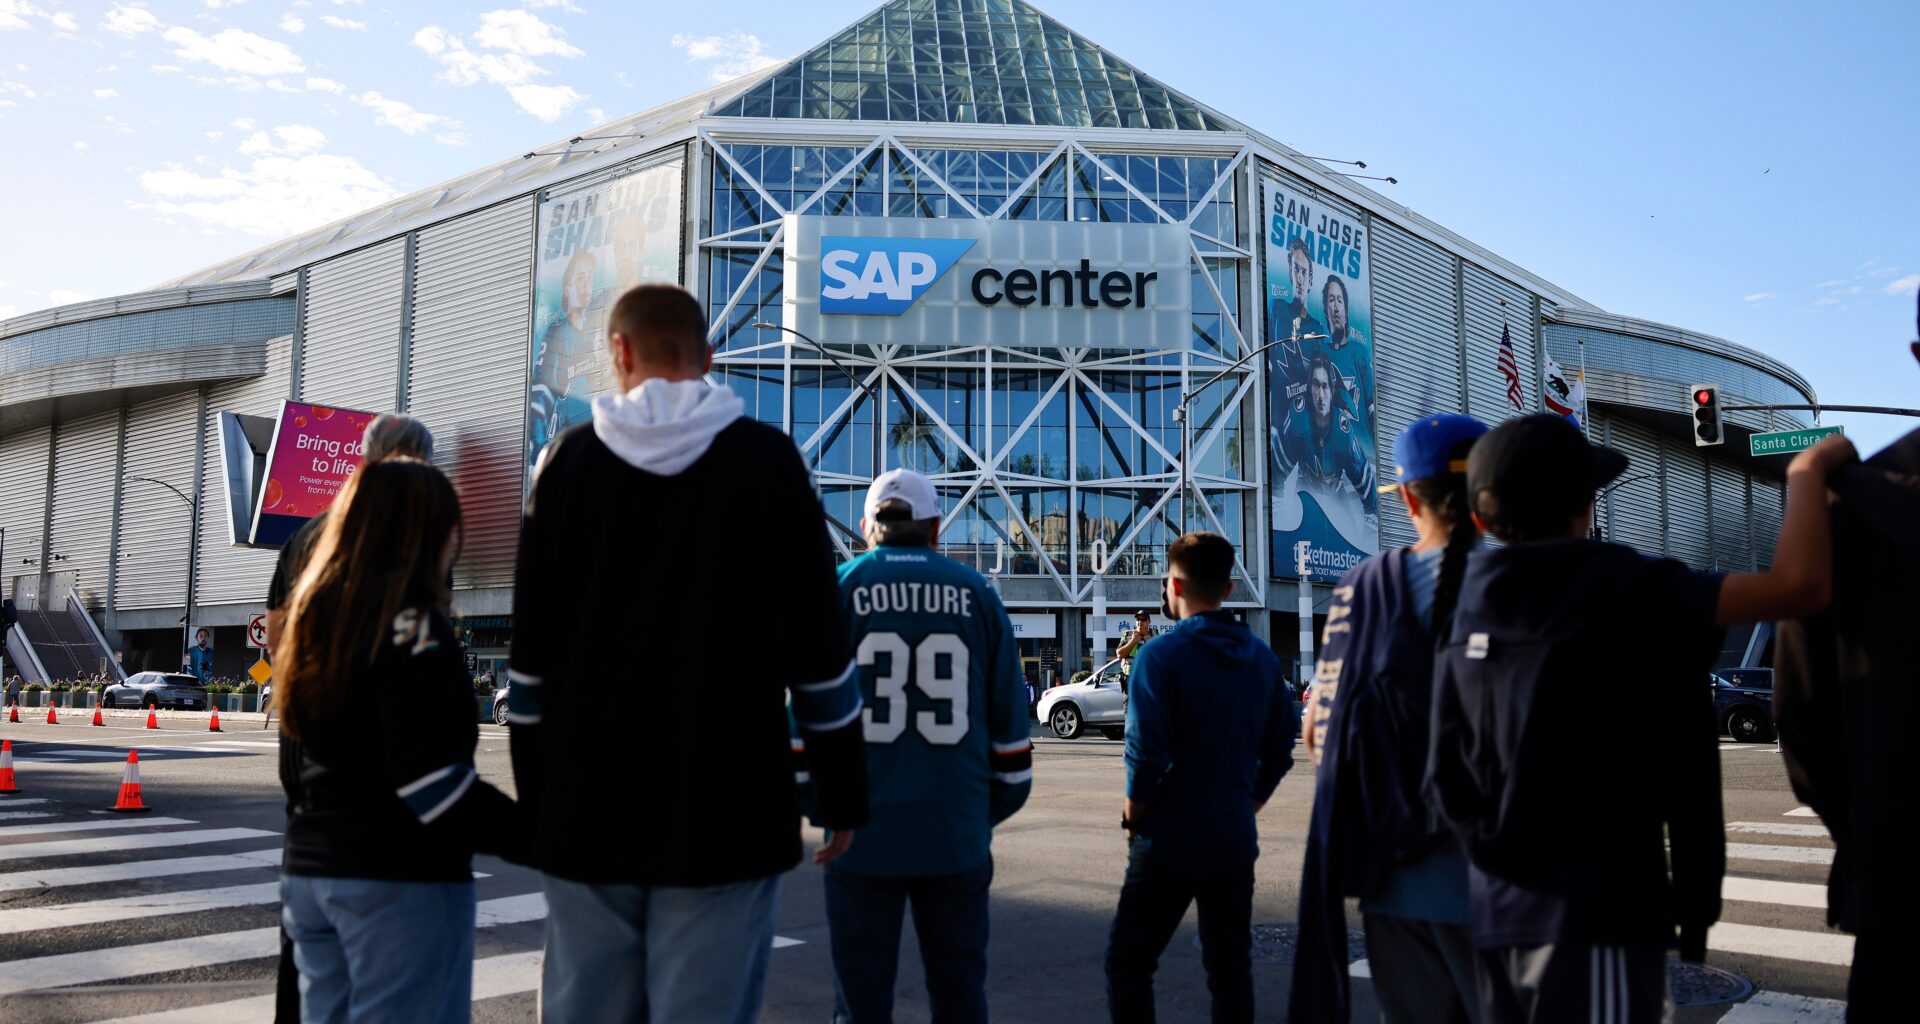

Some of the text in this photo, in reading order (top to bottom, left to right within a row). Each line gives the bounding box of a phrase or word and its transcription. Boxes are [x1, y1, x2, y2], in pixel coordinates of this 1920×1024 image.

[550, 193, 599, 228] SAN
[1273, 191, 1363, 251] SAN JOSE
[1270, 213, 1361, 280] SHARKS
[821, 249, 1158, 308] SAP center
[296, 433, 341, 457] Bring
[1754, 437, 1786, 450] Santa
[1790, 435, 1821, 447] Clara
[300, 475, 324, 486] Power
[312, 457, 356, 475] to life
[307, 486, 327, 496] from
[1293, 543, 1361, 569] tketmaster
[853, 582, 972, 617] COUTURE
[857, 631, 970, 745] 39
